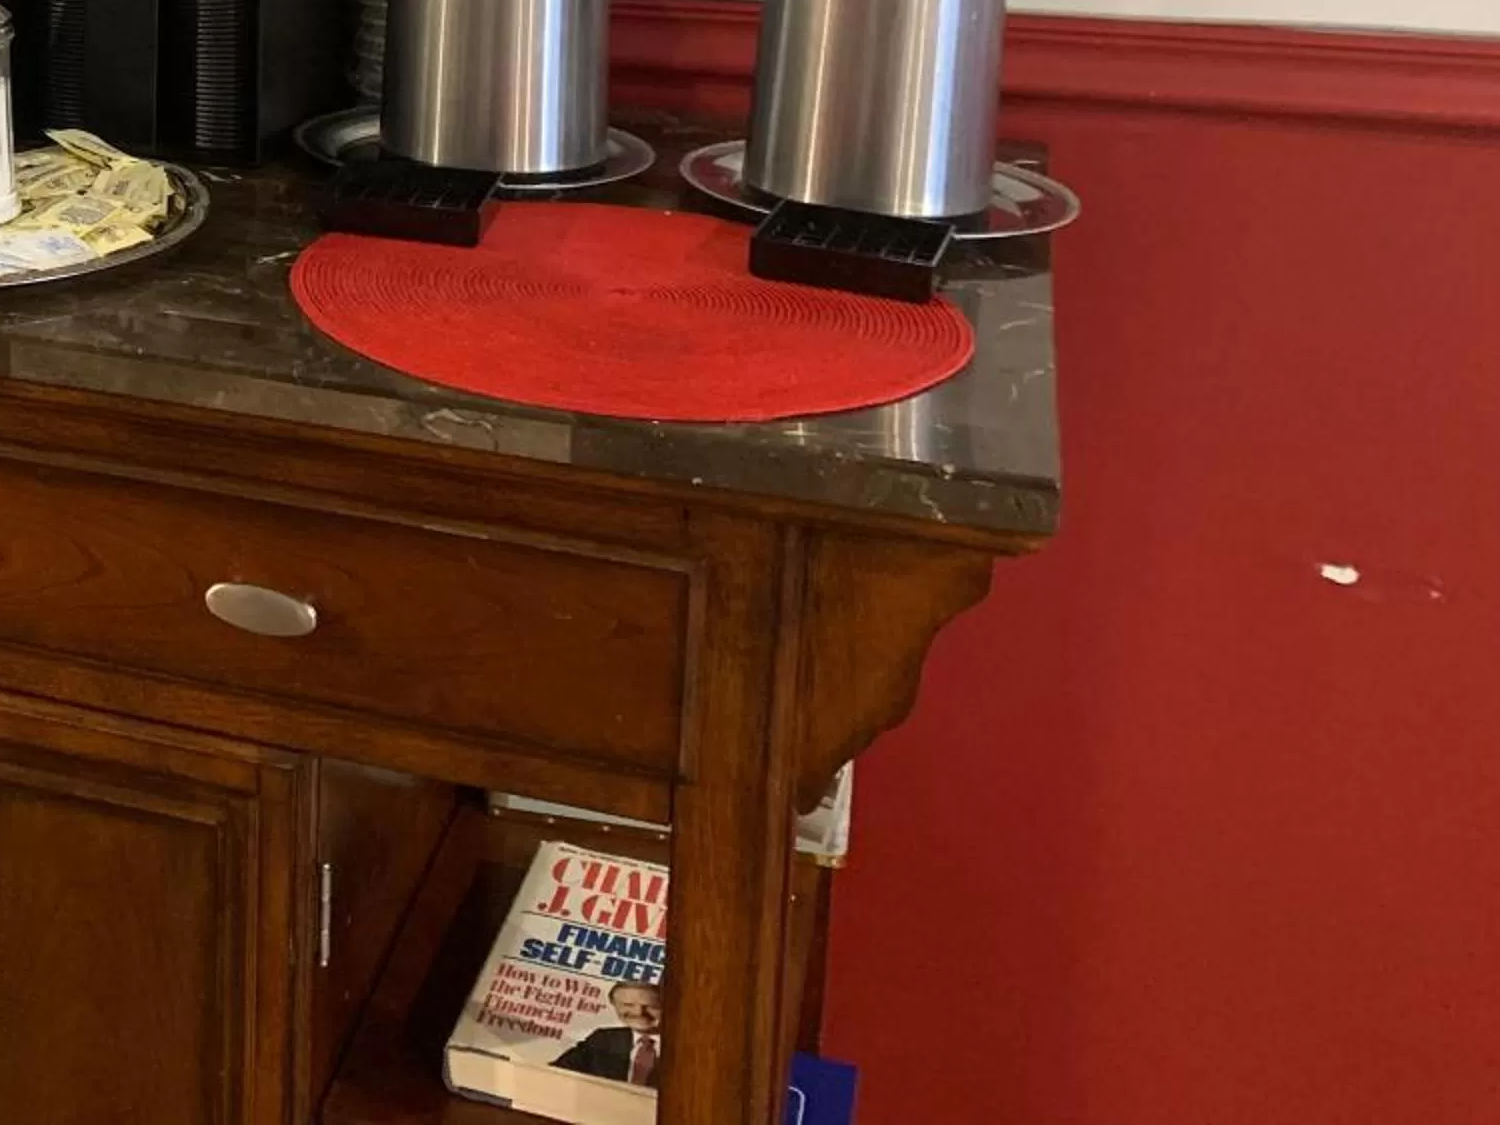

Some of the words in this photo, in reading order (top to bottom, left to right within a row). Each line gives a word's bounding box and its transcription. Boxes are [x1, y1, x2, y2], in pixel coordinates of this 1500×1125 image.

[490, 979, 521, 995] the
[576, 997, 606, 1014] for
[497, 962, 537, 984] How
[542, 975, 561, 988] to
[565, 977, 601, 998] Win
[483, 992, 573, 1025] Financial
